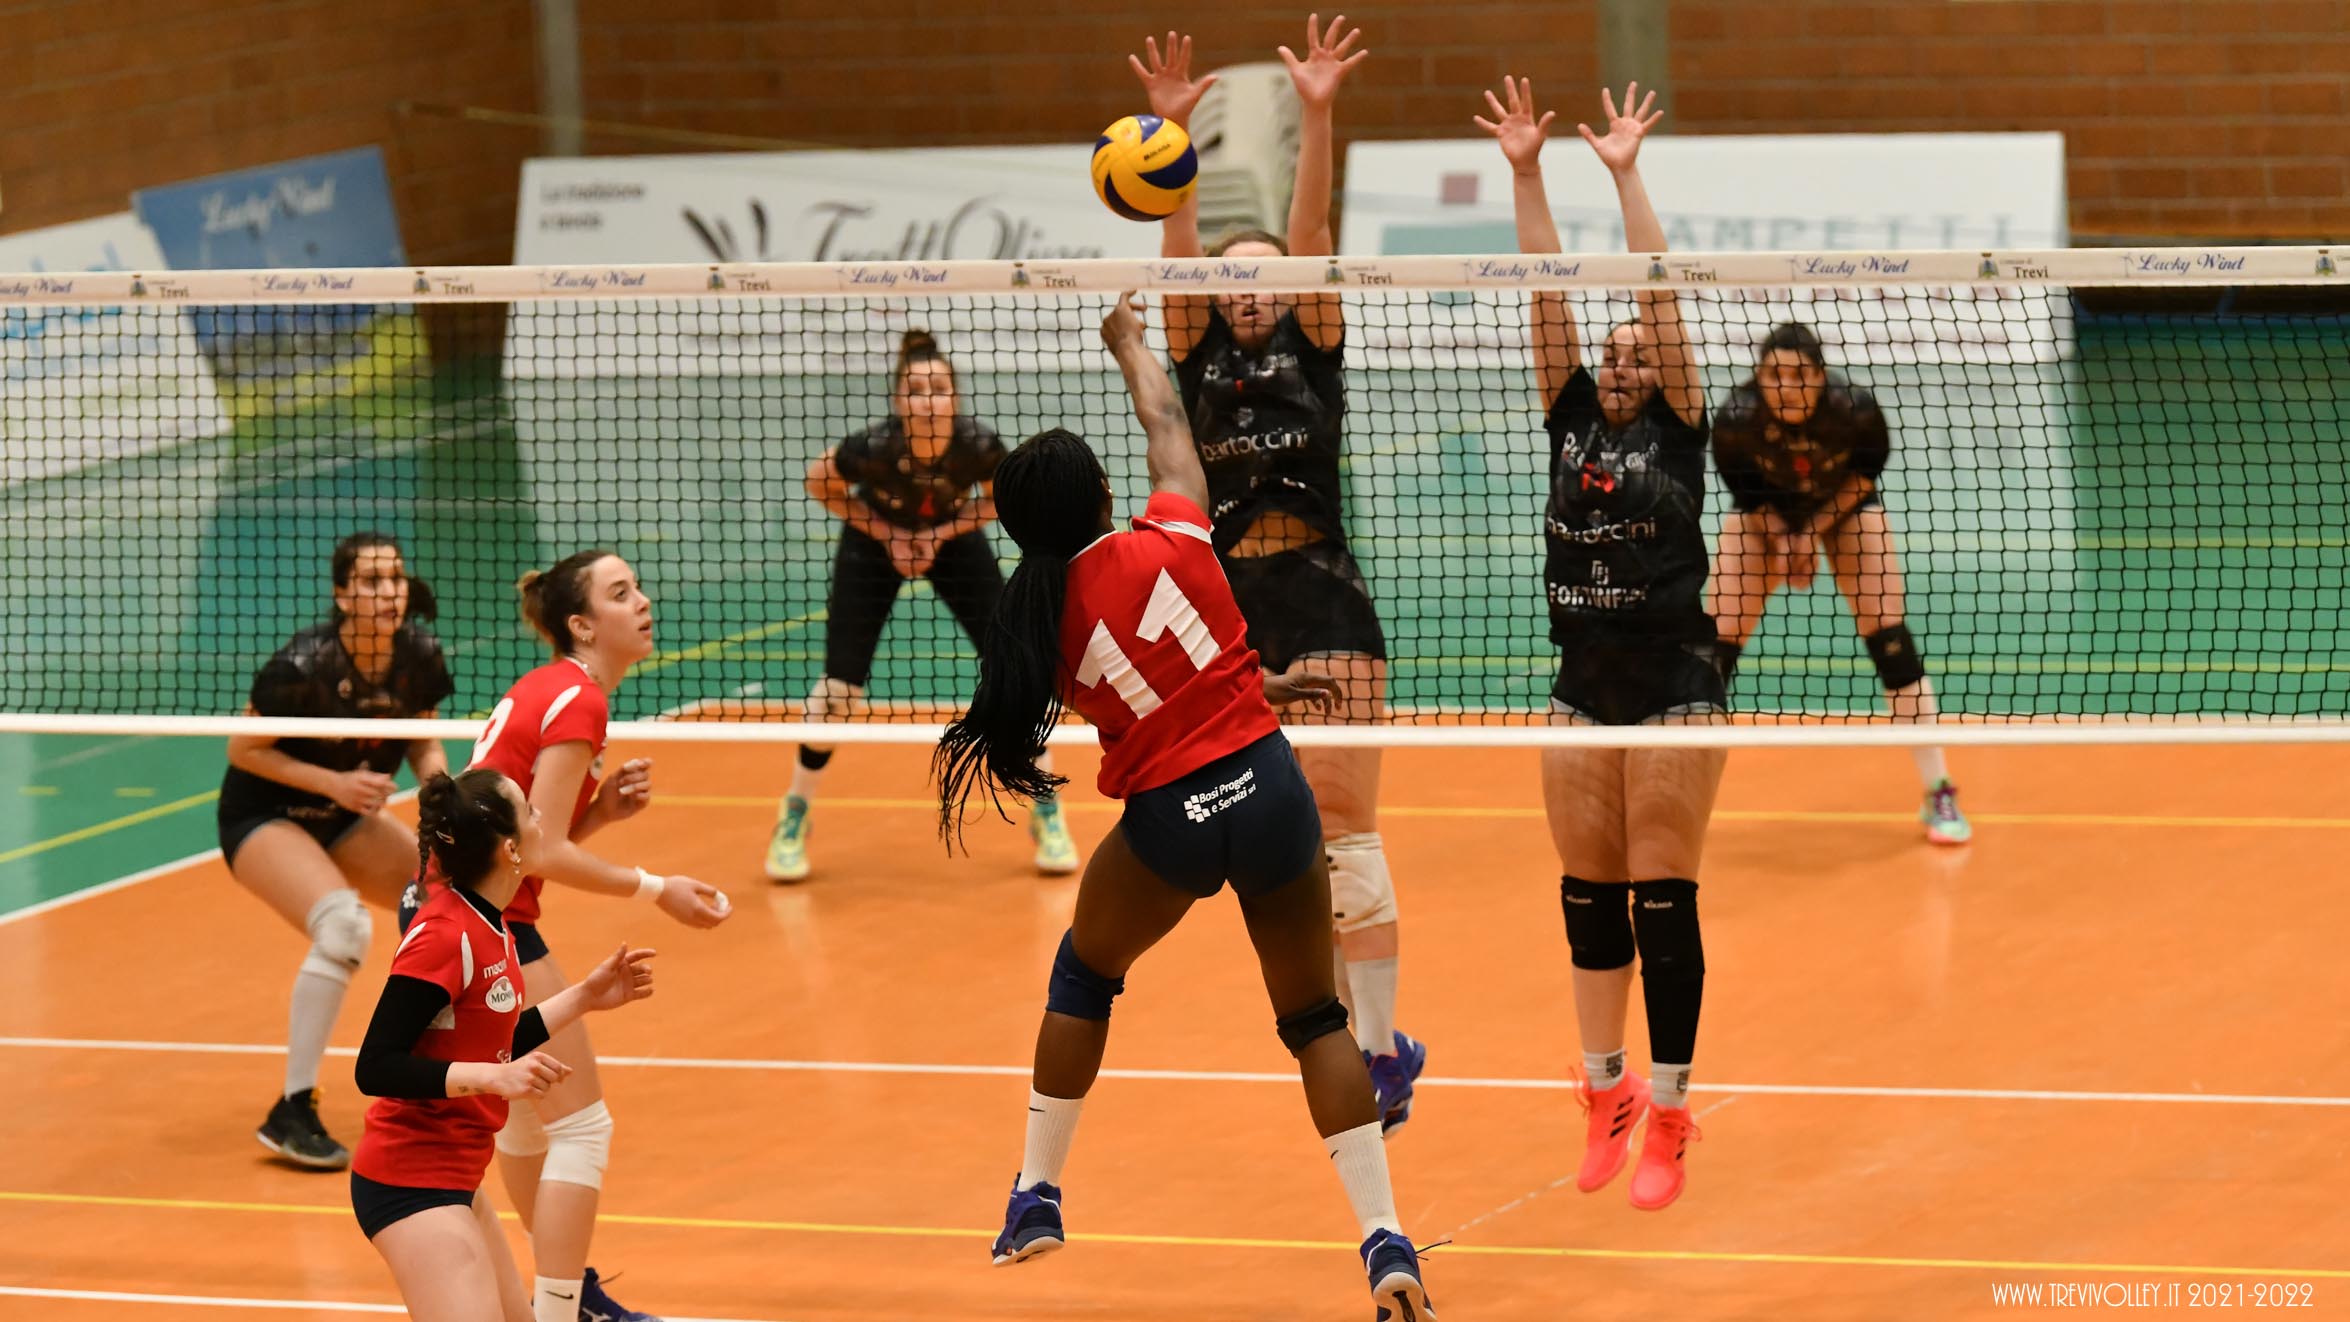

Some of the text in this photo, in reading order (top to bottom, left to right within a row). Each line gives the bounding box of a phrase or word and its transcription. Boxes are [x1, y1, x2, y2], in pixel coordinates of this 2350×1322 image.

[1160, 262, 1260, 285] Lucky Wind
[1478, 259, 1581, 280] Lucky Wind
[1804, 255, 1909, 277] Lucky Wind
[2014, 265, 2049, 278] Trevi
[2138, 252, 2246, 275] Lucky Wind
[552, 270, 647, 289] Lucky Wind
[738, 279, 772, 291] Trevi
[851, 265, 948, 288] Lucky Wind
[1043, 275, 1077, 288] Trevi
[1359, 273, 1393, 286] Trevi
[1682, 269, 1717, 281] Trevi
[0, 278, 74, 296] ucky Wind
[264, 276, 354, 296] Lucky Wind
[444, 283, 475, 295] Trevi
[1201, 427, 1308, 462] bartoccini
[1076, 566, 1222, 720] 11
[1199, 767, 1254, 803] Bosi Progetti
[1211, 783, 1257, 813] e Servizi srl
